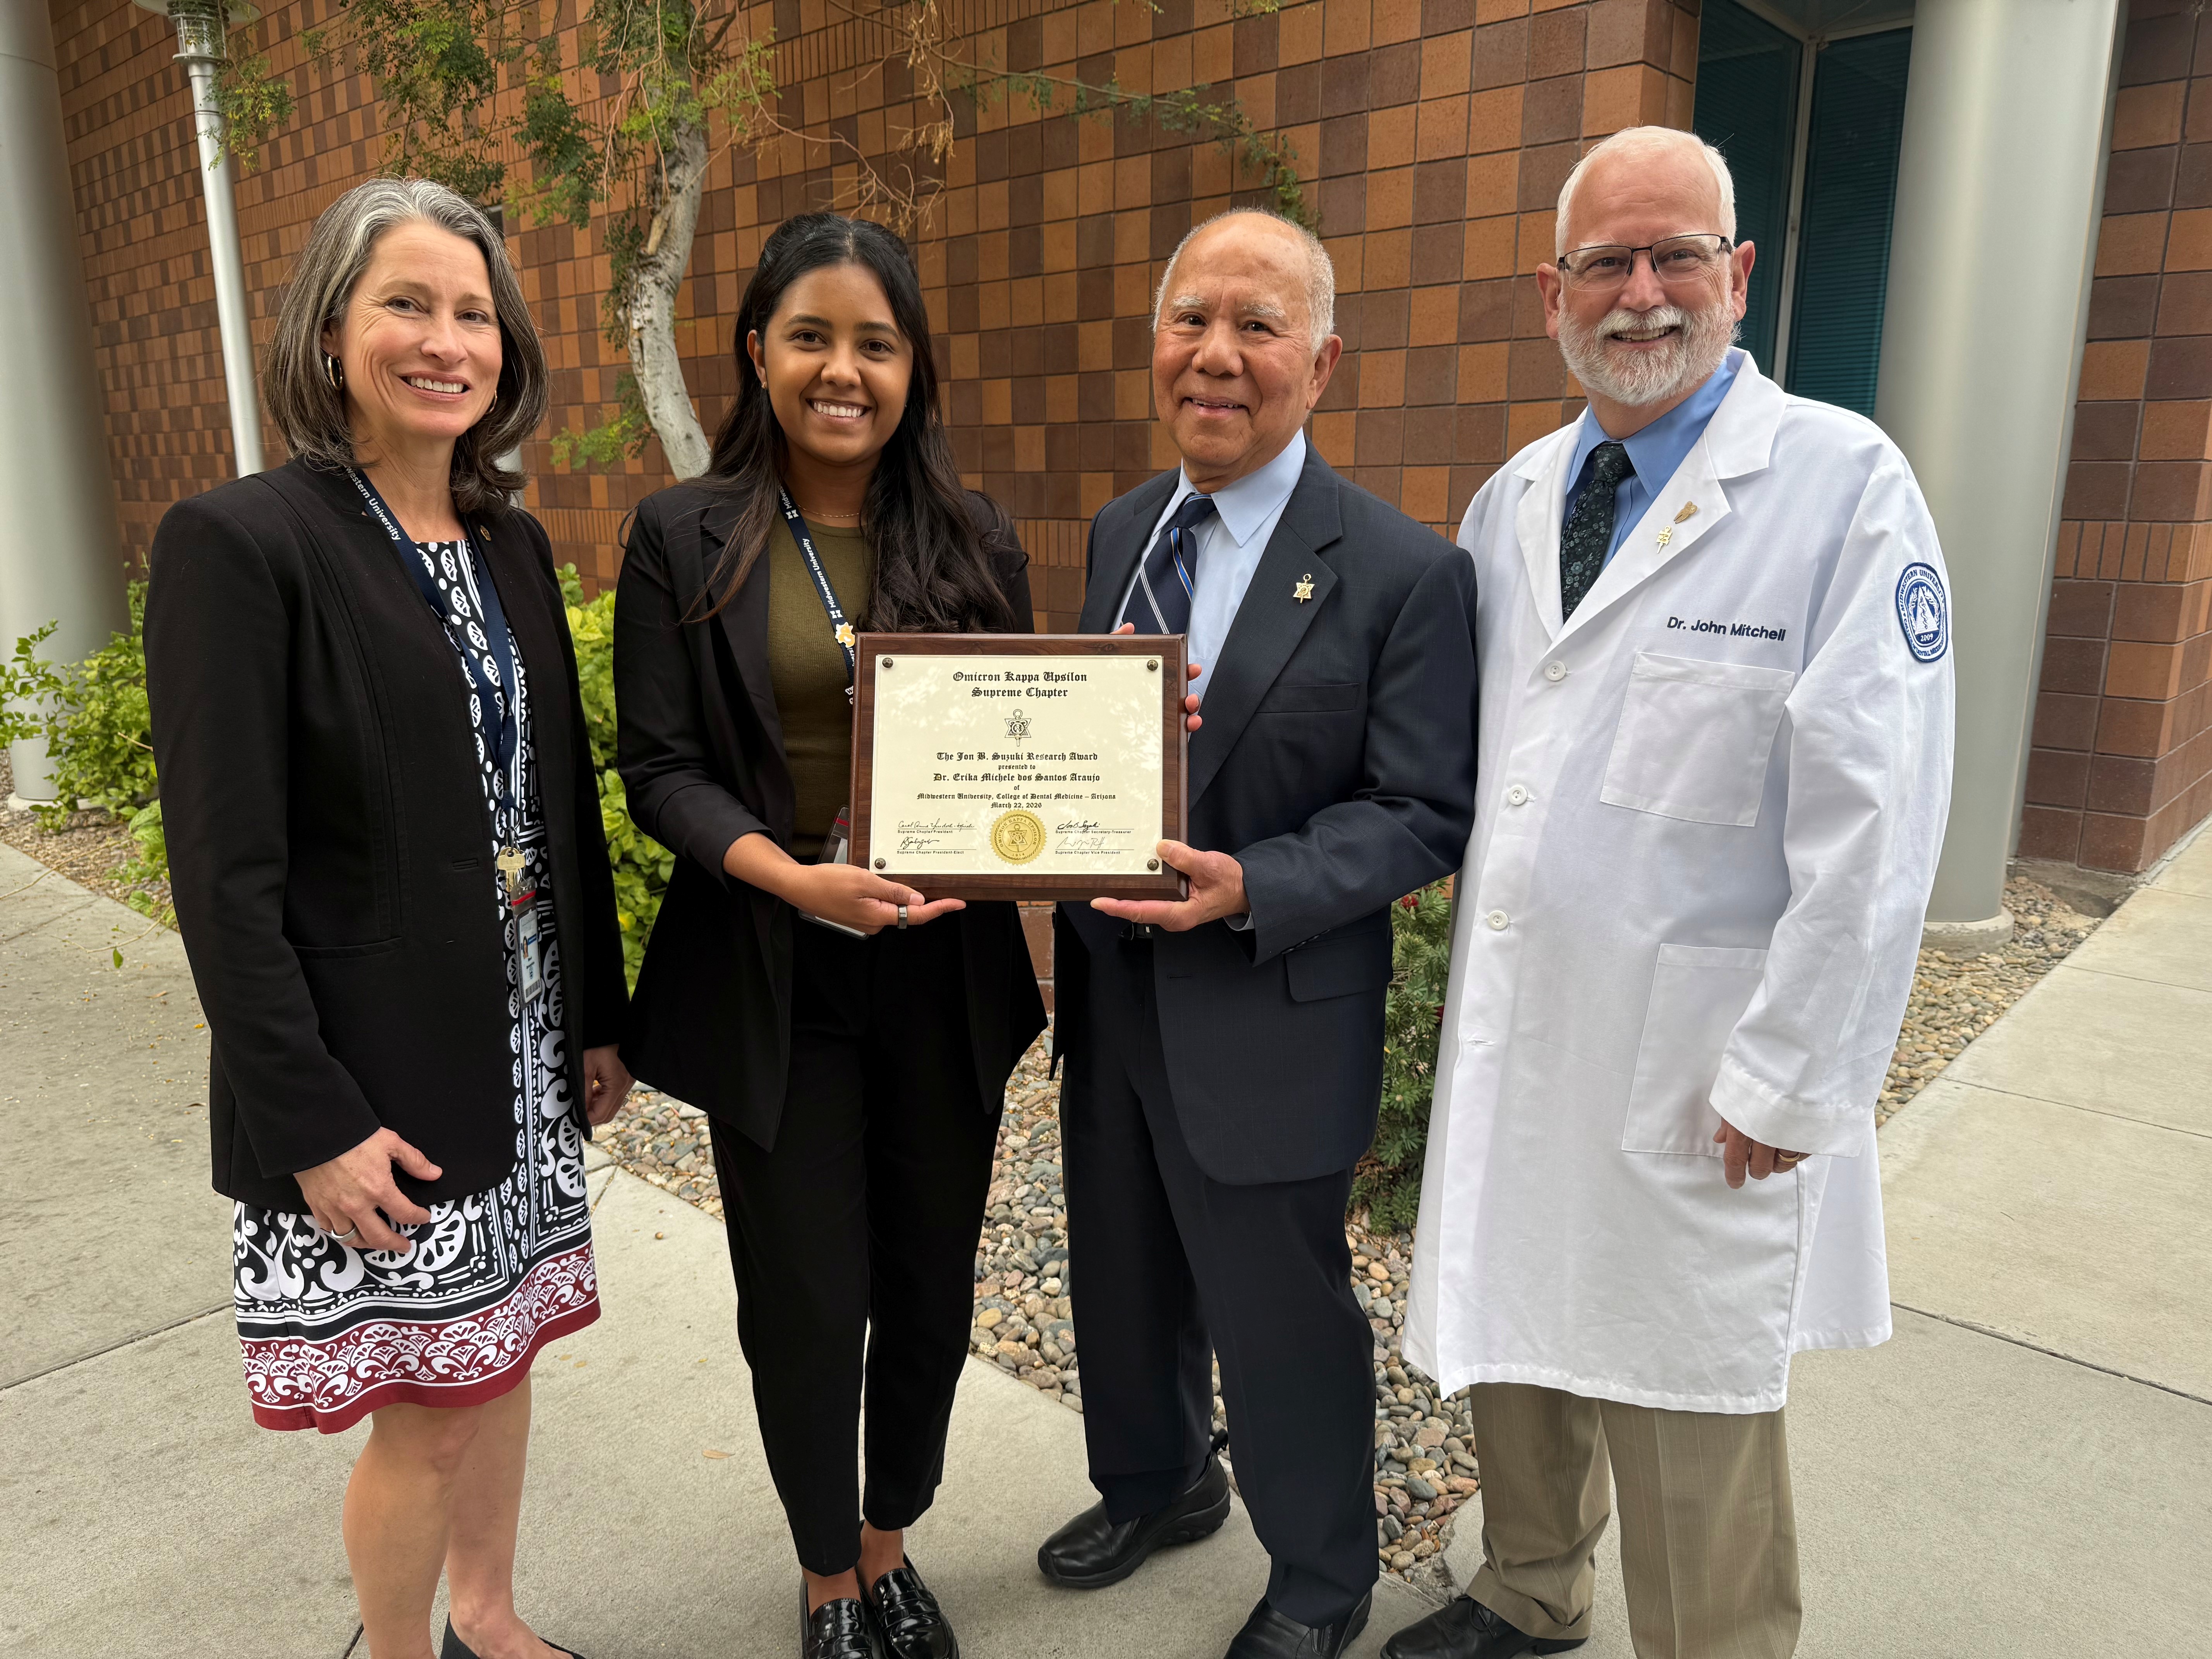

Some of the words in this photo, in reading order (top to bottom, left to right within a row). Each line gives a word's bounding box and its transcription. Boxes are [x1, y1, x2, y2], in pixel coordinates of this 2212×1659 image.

[346, 466, 371, 498] western
[369, 498, 401, 540] University
[802, 538, 819, 570] University
[817, 571, 836, 608] Midwestern
[1667, 617, 1686, 630] Dr.
[1691, 620, 1727, 634] John
[1730, 623, 1786, 641] Mitchell
[1920, 633, 1934, 642] 2009
[953, 671, 1000, 681] Omicron
[1004, 671, 1039, 683] Kappa
[1043, 671, 1087, 683] Upsilon
[971, 687, 1022, 698] Supreme
[1026, 687, 1068, 699] Chapter
[936, 752, 954, 761] The
[956, 752, 974, 761] Jon
[977, 752, 988, 761] B.
[991, 752, 1024, 762] Suzuki
[1026, 752, 1066, 762] Research
[1069, 752, 1098, 761] Award
[933, 773, 950, 781] Dr.
[953, 773, 978, 781] Erika
[981, 773, 1015, 782] Michele
[1035, 773, 1067, 781] Santos
[1070, 773, 1100, 783] Araujo
